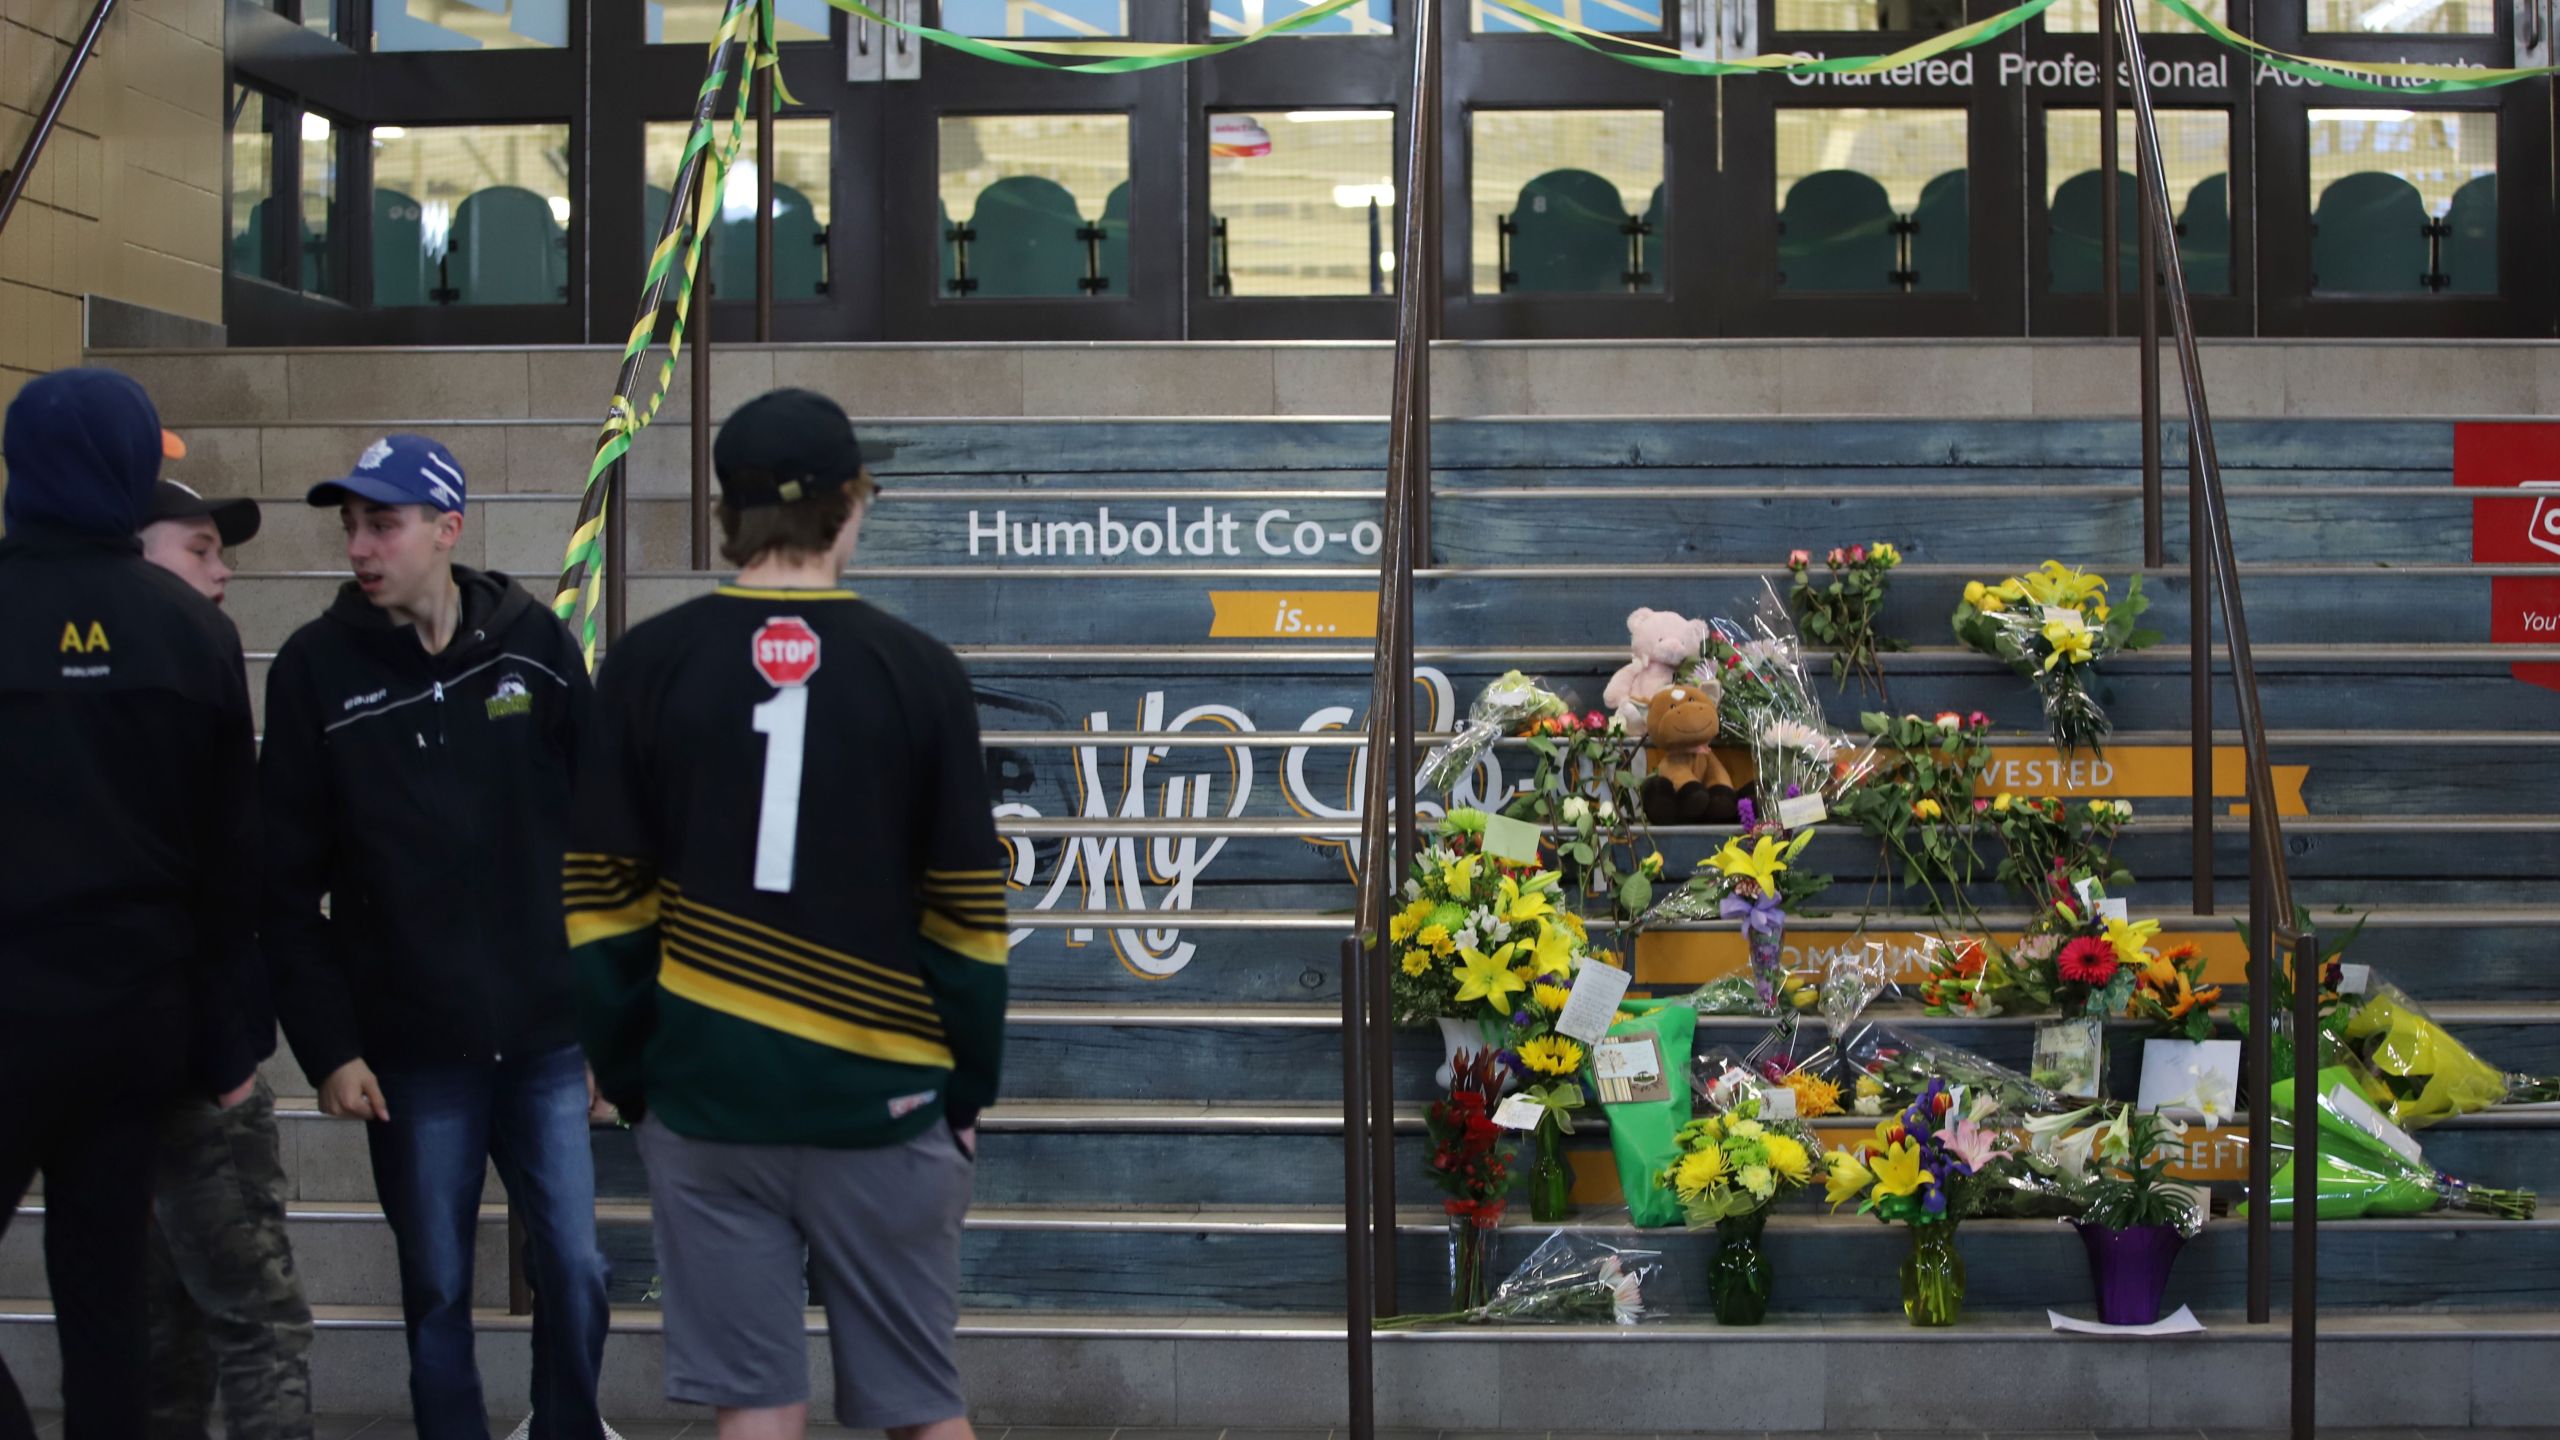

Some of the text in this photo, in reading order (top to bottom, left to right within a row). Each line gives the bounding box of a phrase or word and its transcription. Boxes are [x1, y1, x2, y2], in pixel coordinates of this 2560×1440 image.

[968, 506, 1384, 557] Humboldt Co-o
[1273, 599, 1337, 633] is...
[60, 621, 111, 653] AA
[759, 639, 814, 663] STOP
[753, 685, 808, 893] 1
